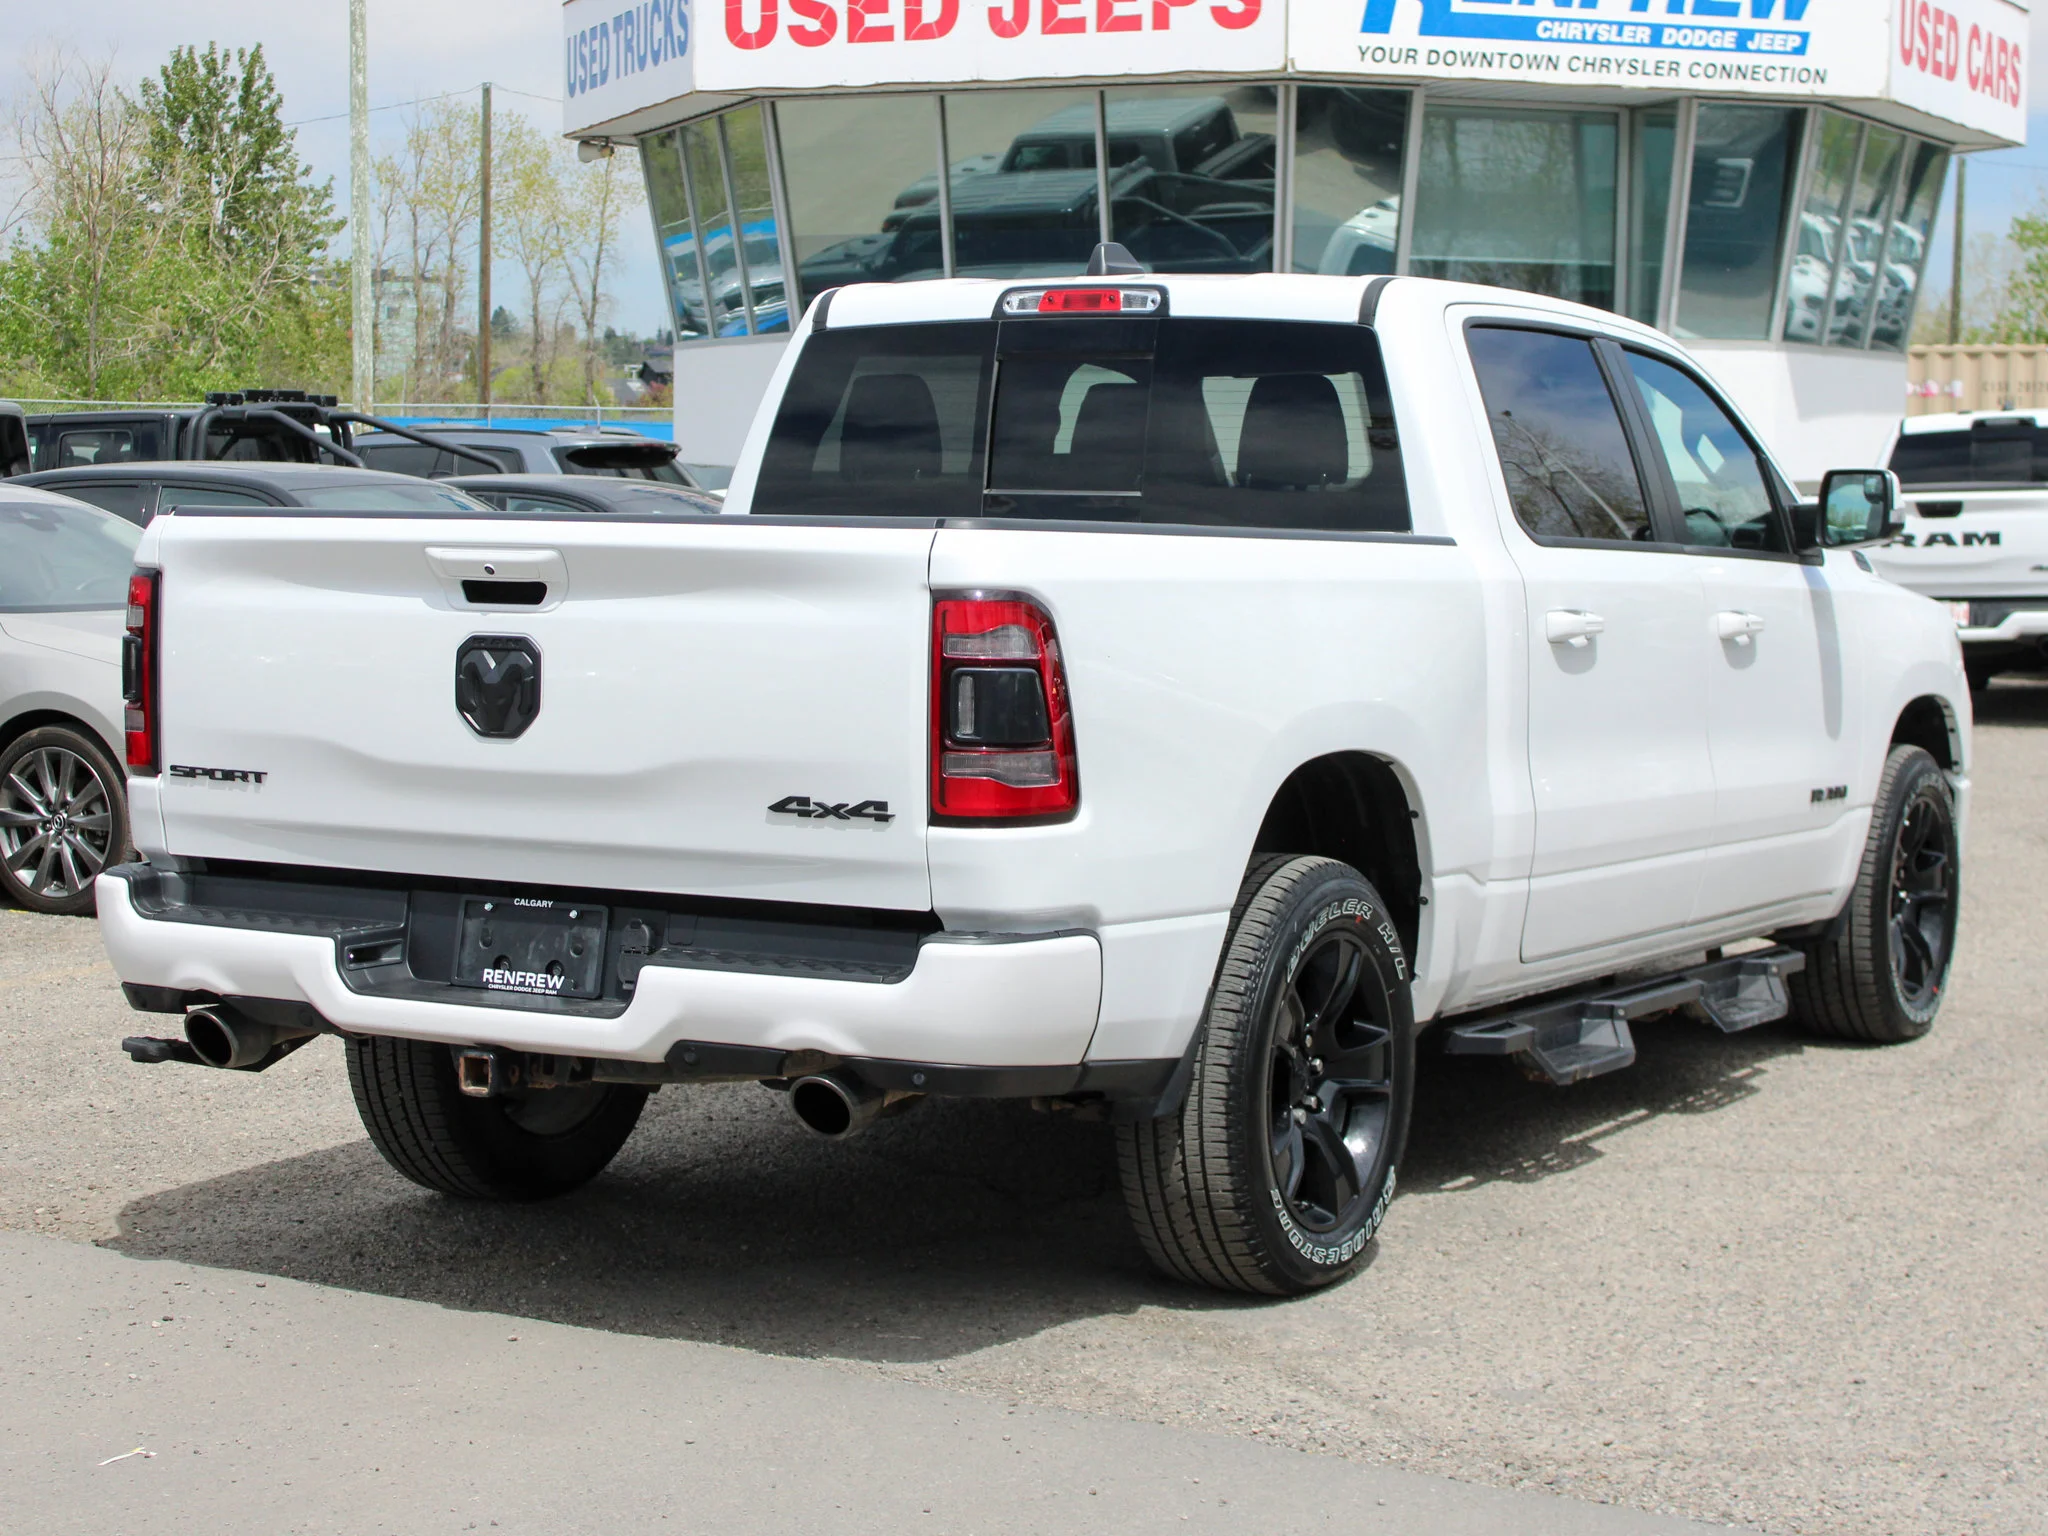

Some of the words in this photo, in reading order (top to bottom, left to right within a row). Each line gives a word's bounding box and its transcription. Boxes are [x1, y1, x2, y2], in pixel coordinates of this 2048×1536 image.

[725, 0, 960, 50] USED
[1536, 20, 1652, 43] CHRYSLER
[1661, 27, 1738, 49] DODGE
[1747, 32, 1802, 52] JEEP
[567, 22, 609, 98] USED
[613, 0, 689, 79] TRUCKS
[1357, 45, 1418, 65] YOUR
[1427, 49, 1560, 71] DOWNTOWN
[1567, 55, 1681, 78] CHRYSLER
[1688, 62, 1828, 84] CONNECTION
[1901, 0, 1960, 82] USED
[1967, 23, 2021, 109] CARS
[170, 764, 268, 784] SPORT
[514, 898, 553, 908] CALGARY
[482, 968, 565, 989] RENFREW
[488, 983, 514, 991] CHRYSLER
[514, 985, 532, 993] DODGE
